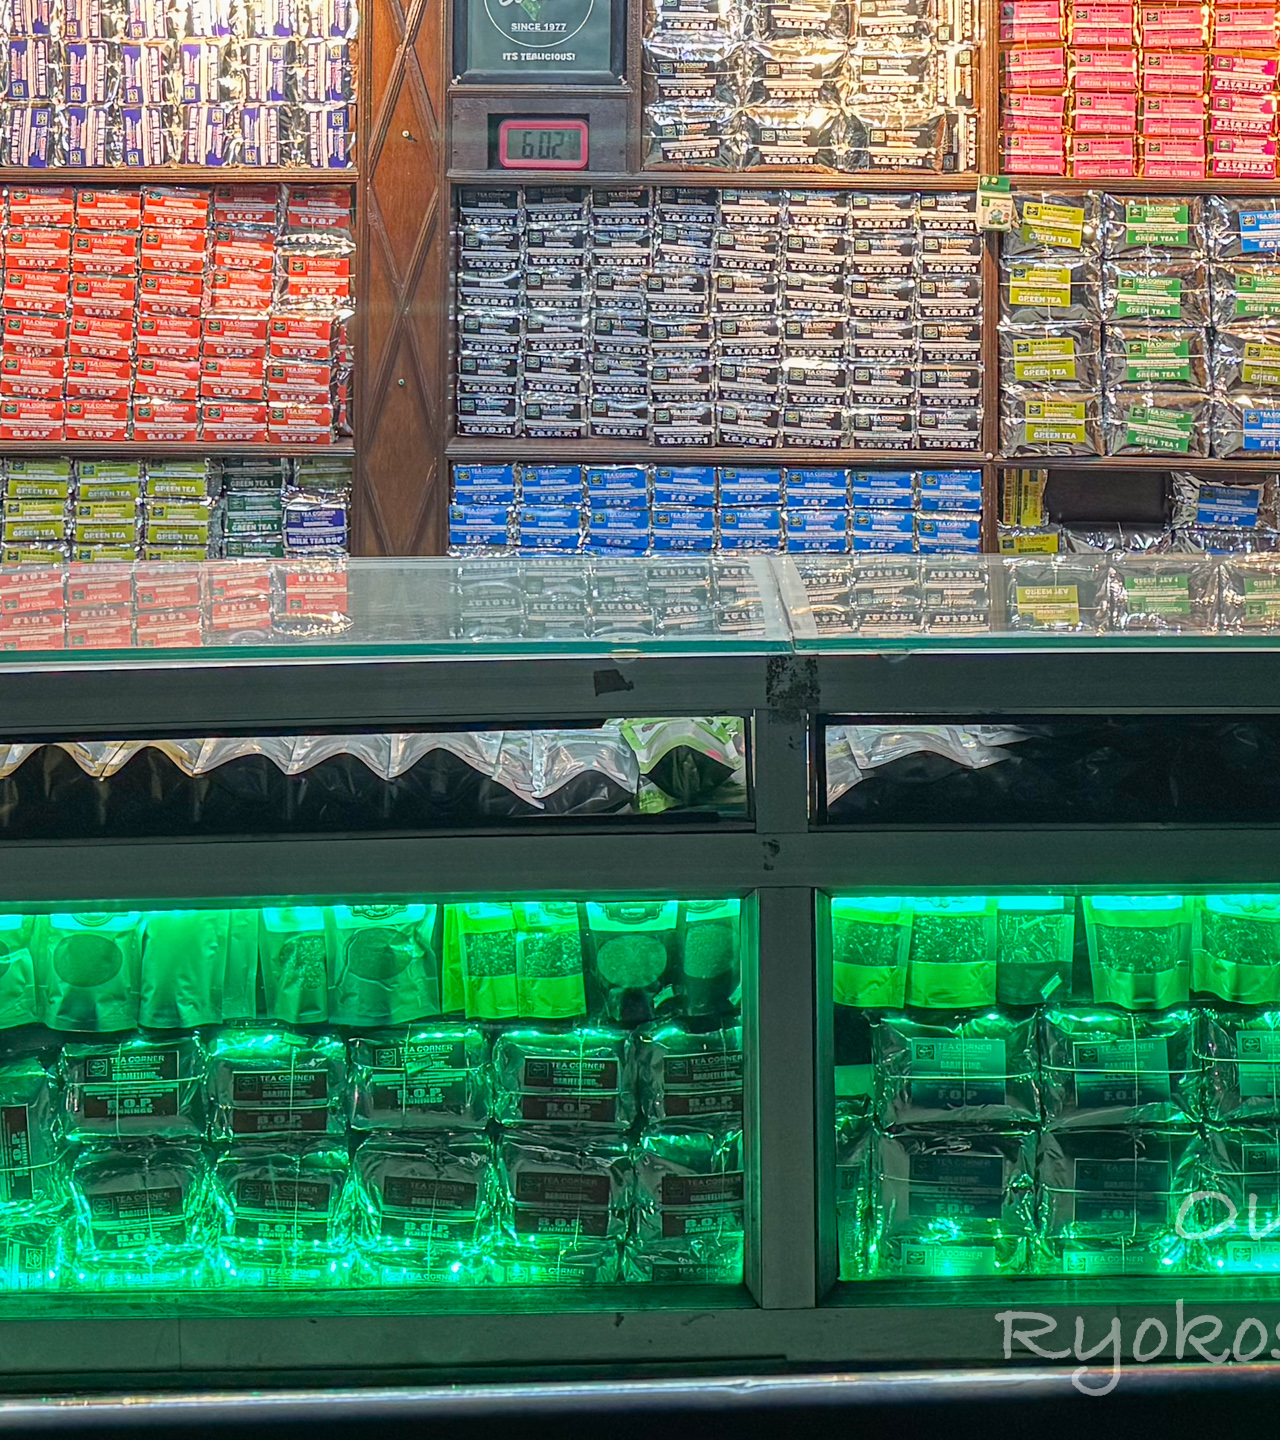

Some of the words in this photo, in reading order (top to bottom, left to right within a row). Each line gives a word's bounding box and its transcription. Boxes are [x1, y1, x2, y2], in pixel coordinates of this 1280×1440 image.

[511, 22, 541, 31] SINCE
[543, 22, 567, 31] 1977
[502, 52, 518, 61] ITS
[1263, 1036, 1280, 1044] TEA
[398, 1046, 415, 1054] TEA
[416, 1044, 453, 1053] CORNER
[954, 1043, 992, 1051] CORNER
[1116, 1043, 1155, 1051] CORNER
[127, 1055, 165, 1063] CORNER
[706, 1055, 742, 1064] CORNER
[551, 1062, 567, 1070] TEA
[568, 1062, 605, 1070] CORNER
[261, 1074, 277, 1082] TEA
[278, 1074, 315, 1082] CORNER
[281, 1185, 318, 1194] CORNER
[133, 1192, 170, 1200] CORNER
